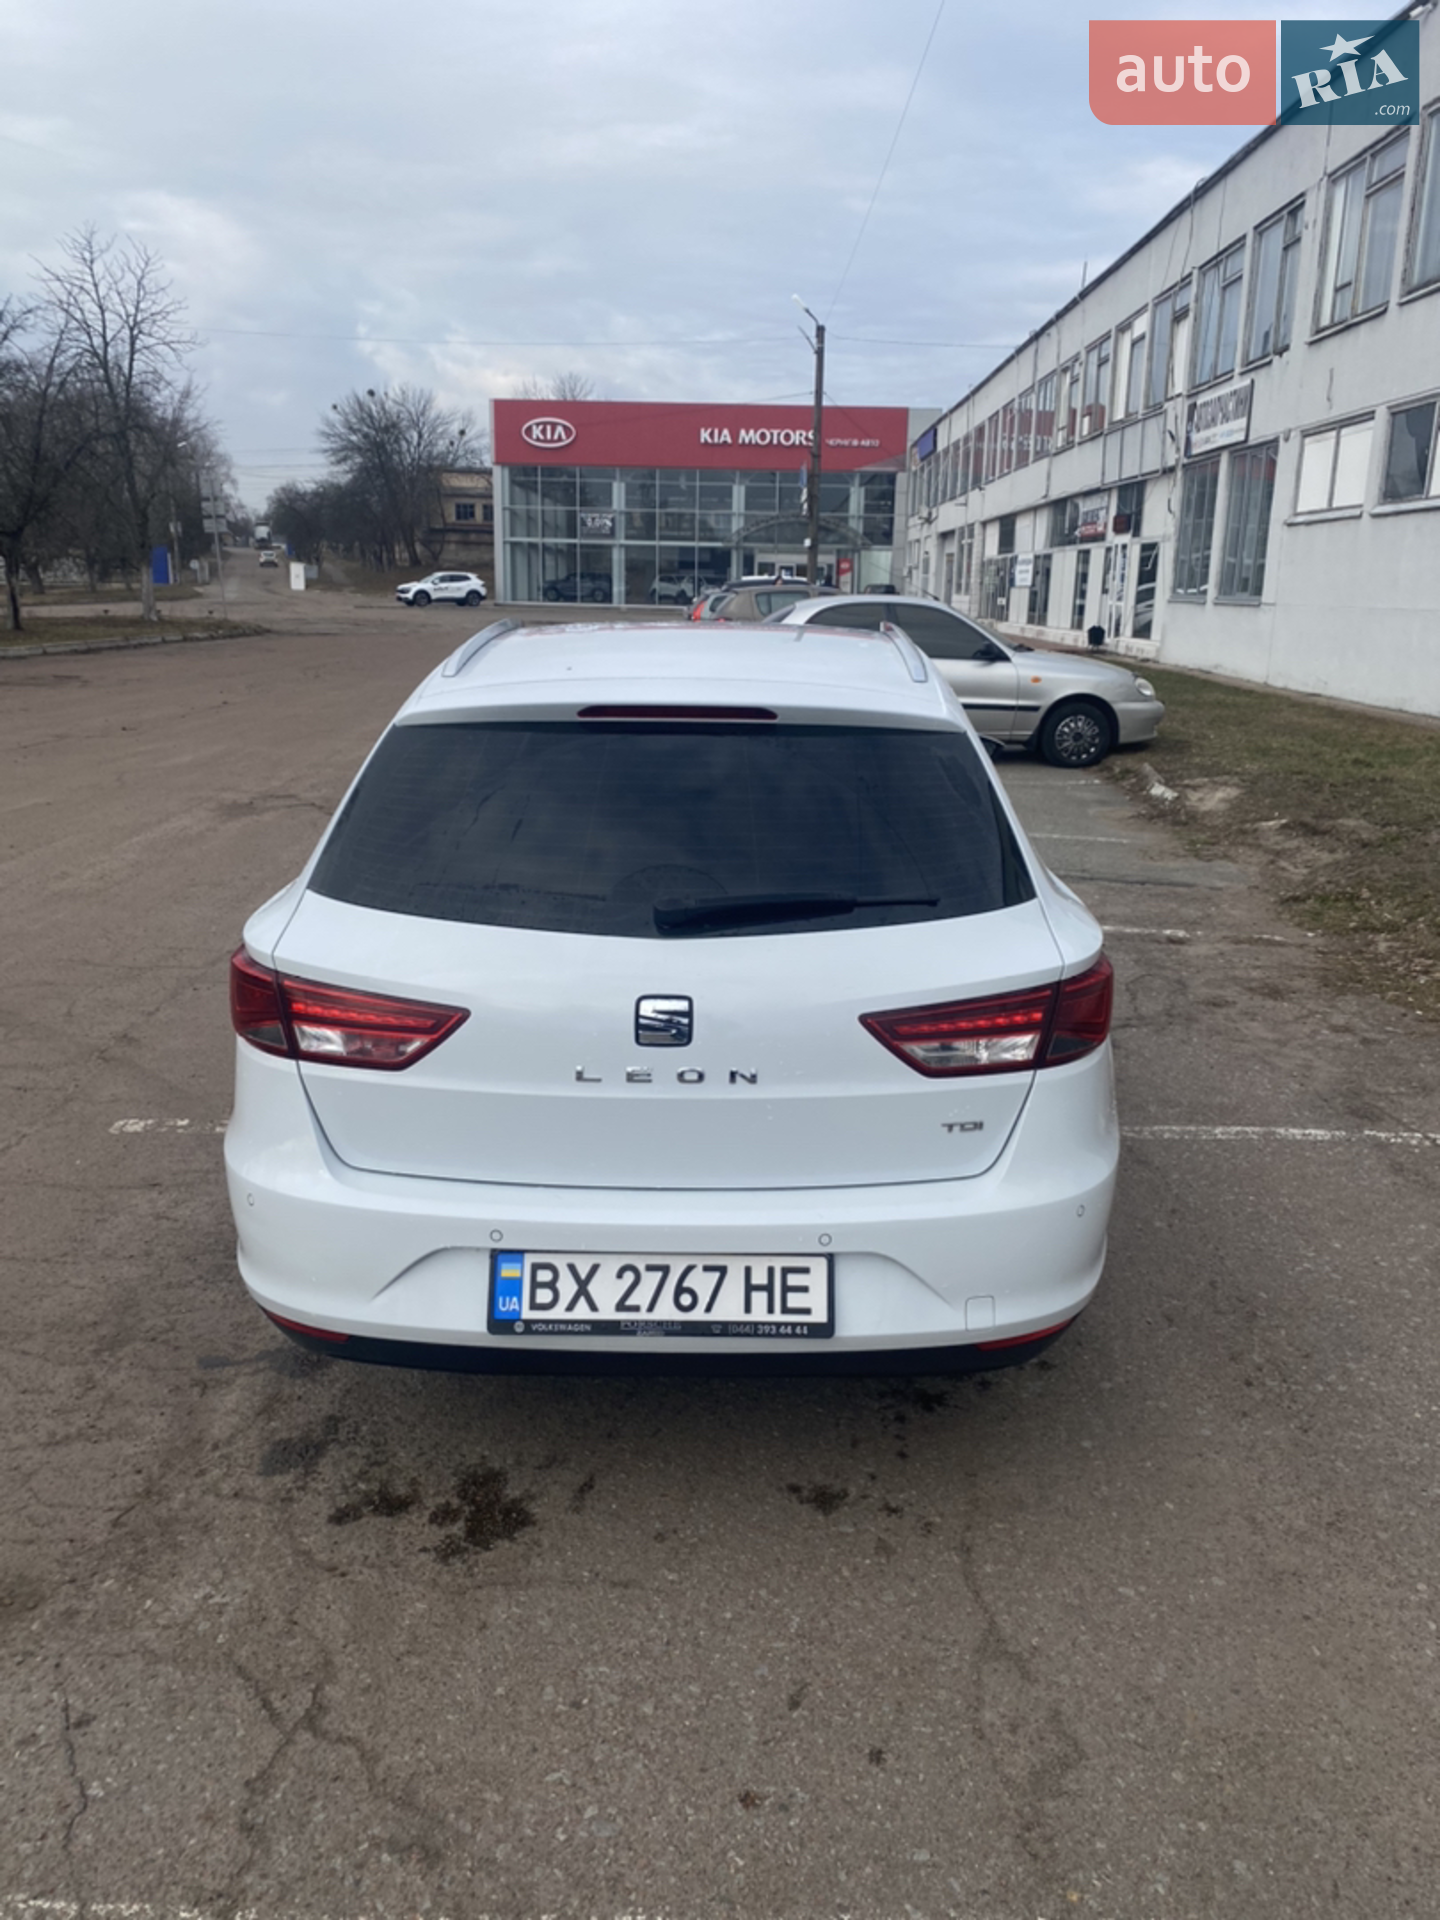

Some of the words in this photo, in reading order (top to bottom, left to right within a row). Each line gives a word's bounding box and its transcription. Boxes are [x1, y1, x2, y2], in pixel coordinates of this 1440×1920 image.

[532, 424, 566, 440] KIA
[700, 427, 732, 444] KIA
[575, 1066, 759, 1085] LEON
[941, 1121, 984, 1134] TDI
[528, 1261, 602, 1313] BX
[613, 1263, 729, 1314] 2767
[743, 1265, 813, 1316] HE
[498, 1296, 520, 1312] UA
[531, 1322, 592, 1332] VOLKSWAGEN
[756, 1324, 777, 1335] 393
